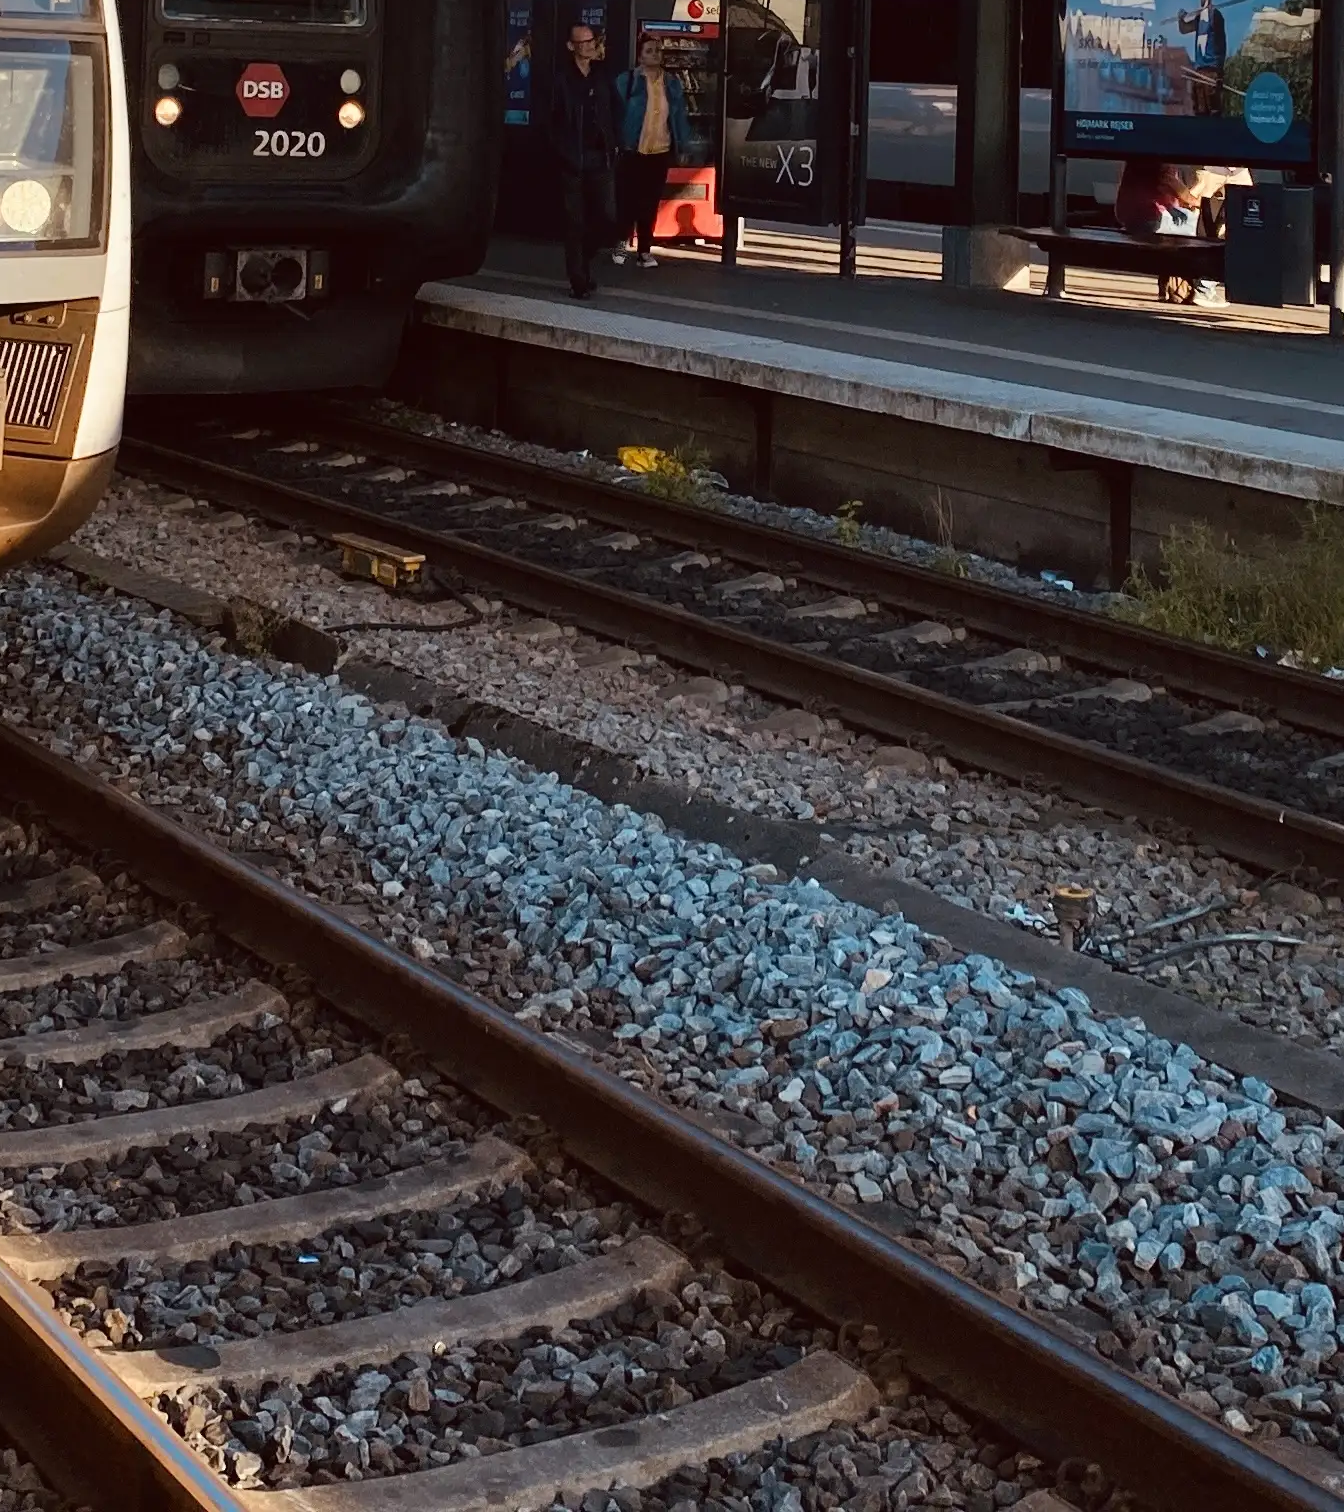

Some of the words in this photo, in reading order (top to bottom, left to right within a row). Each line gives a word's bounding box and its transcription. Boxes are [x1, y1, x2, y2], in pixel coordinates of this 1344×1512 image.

[243, 80, 283, 99] DSB
[253, 130, 326, 157] 2020
[740, 155, 757, 168] THE
[759, 157, 778, 169] NEW
[775, 144, 814, 186] X3
